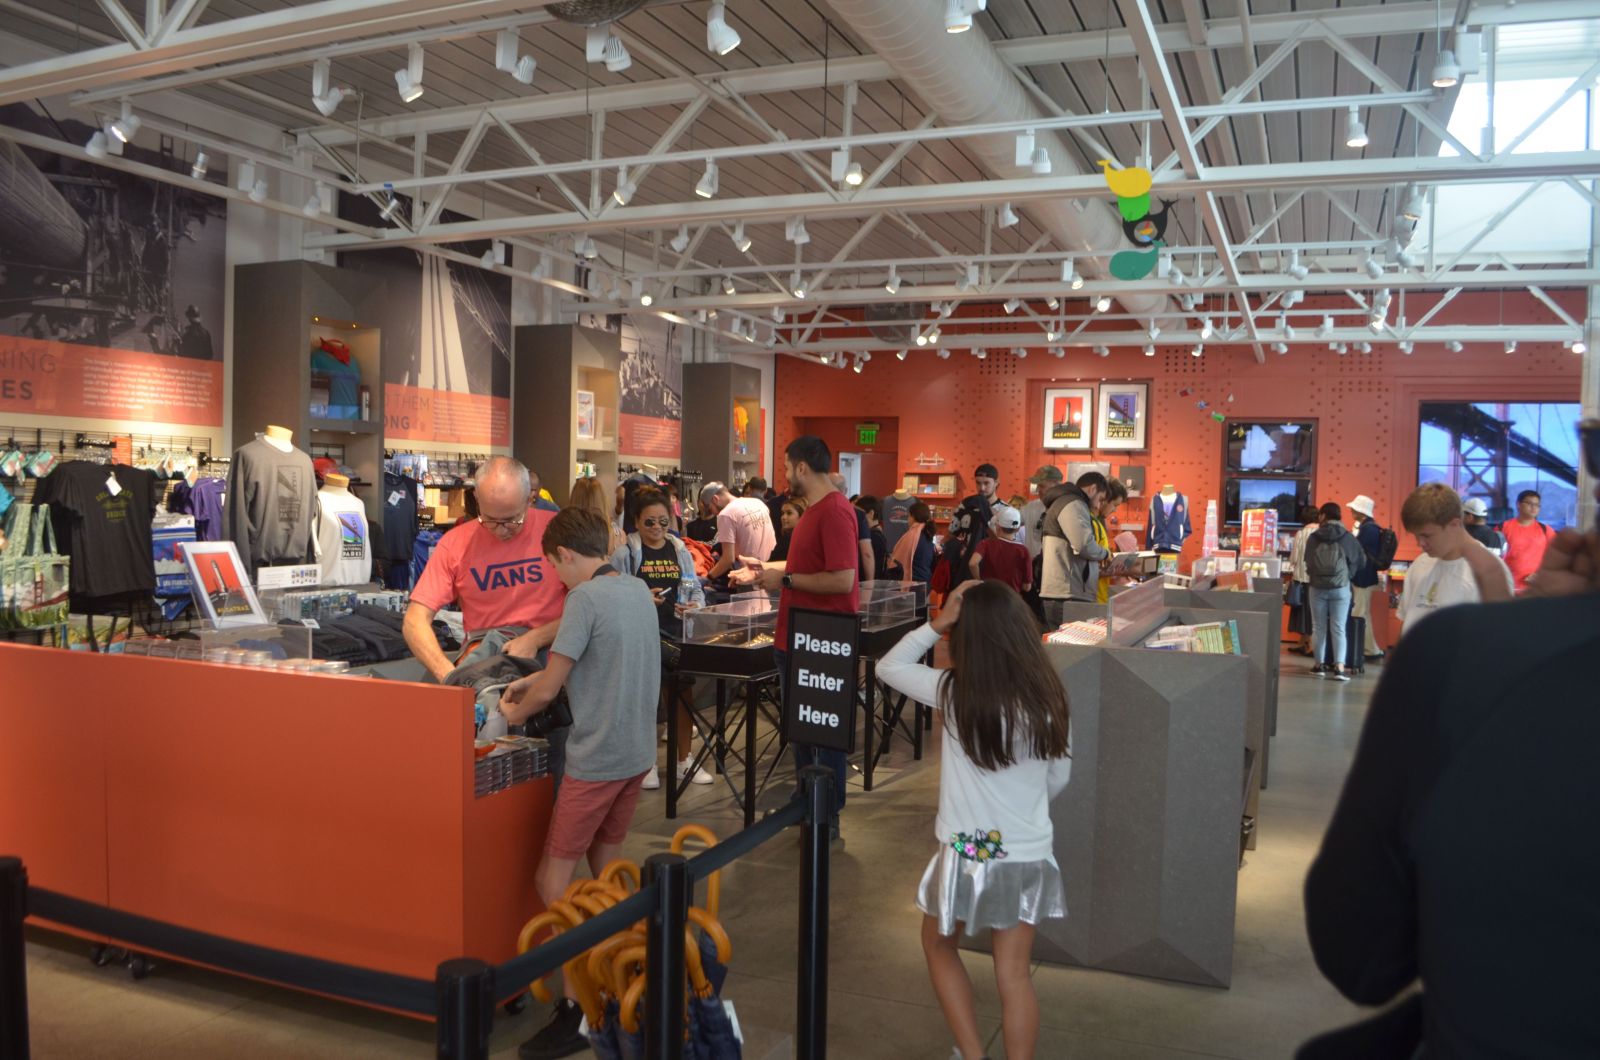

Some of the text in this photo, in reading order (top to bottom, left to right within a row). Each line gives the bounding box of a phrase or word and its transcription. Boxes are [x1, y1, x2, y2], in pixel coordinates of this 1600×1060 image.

[860, 430, 877, 445] EXIT
[470, 557, 543, 592] VANS
[794, 632, 852, 657] Please
[797, 668, 844, 692] Enter
[798, 704, 839, 728] Here
